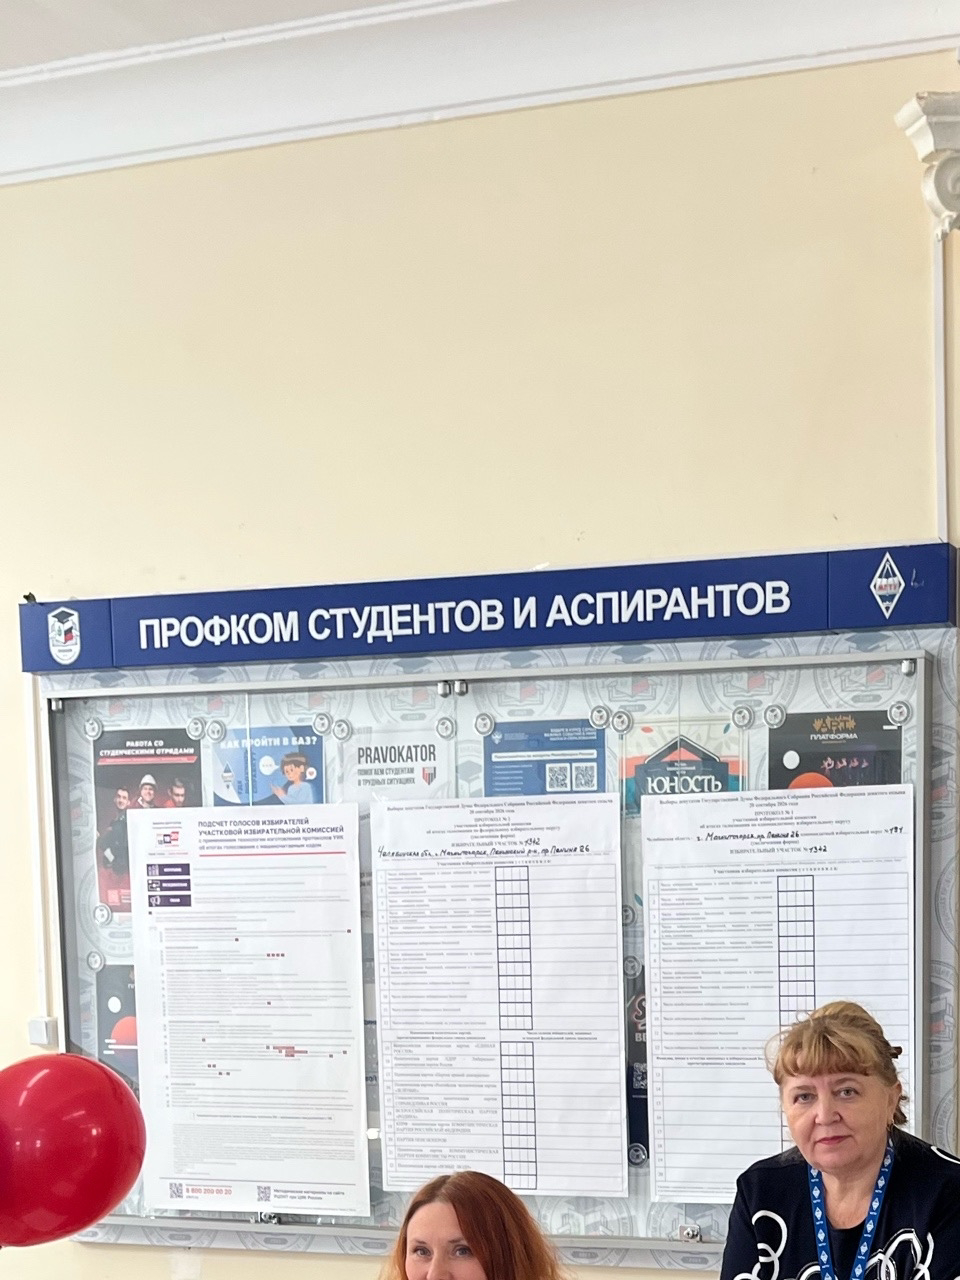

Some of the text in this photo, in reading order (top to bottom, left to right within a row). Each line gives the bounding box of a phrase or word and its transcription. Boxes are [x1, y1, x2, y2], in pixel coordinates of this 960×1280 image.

[139, 580, 791, 650] ПРОФКОМ СТУДЕНТОВ И АСПИРАНТОВ
[126, 740, 153, 748] РАБОТА
[220, 736, 318, 749] КАК ПРОЙТИ В БАЗ?
[100, 748, 154, 756] СТУДЕНЧЕСКИМИ
[358, 744, 436, 764] PRAVOKATOR
[646, 774, 723, 794] ЮНОСТЬ
[198, 820, 228, 828] ПОДСЧЕТ
[262, 817, 310, 826] ИЗБИРАТЕЛЕЙ
[198, 825, 344, 836] УЧАСТКОВОЙ ИЗБИРАТЕЛЬНОЙ КОМИССИЕЙ
[580, 844, 590, 853] 26
